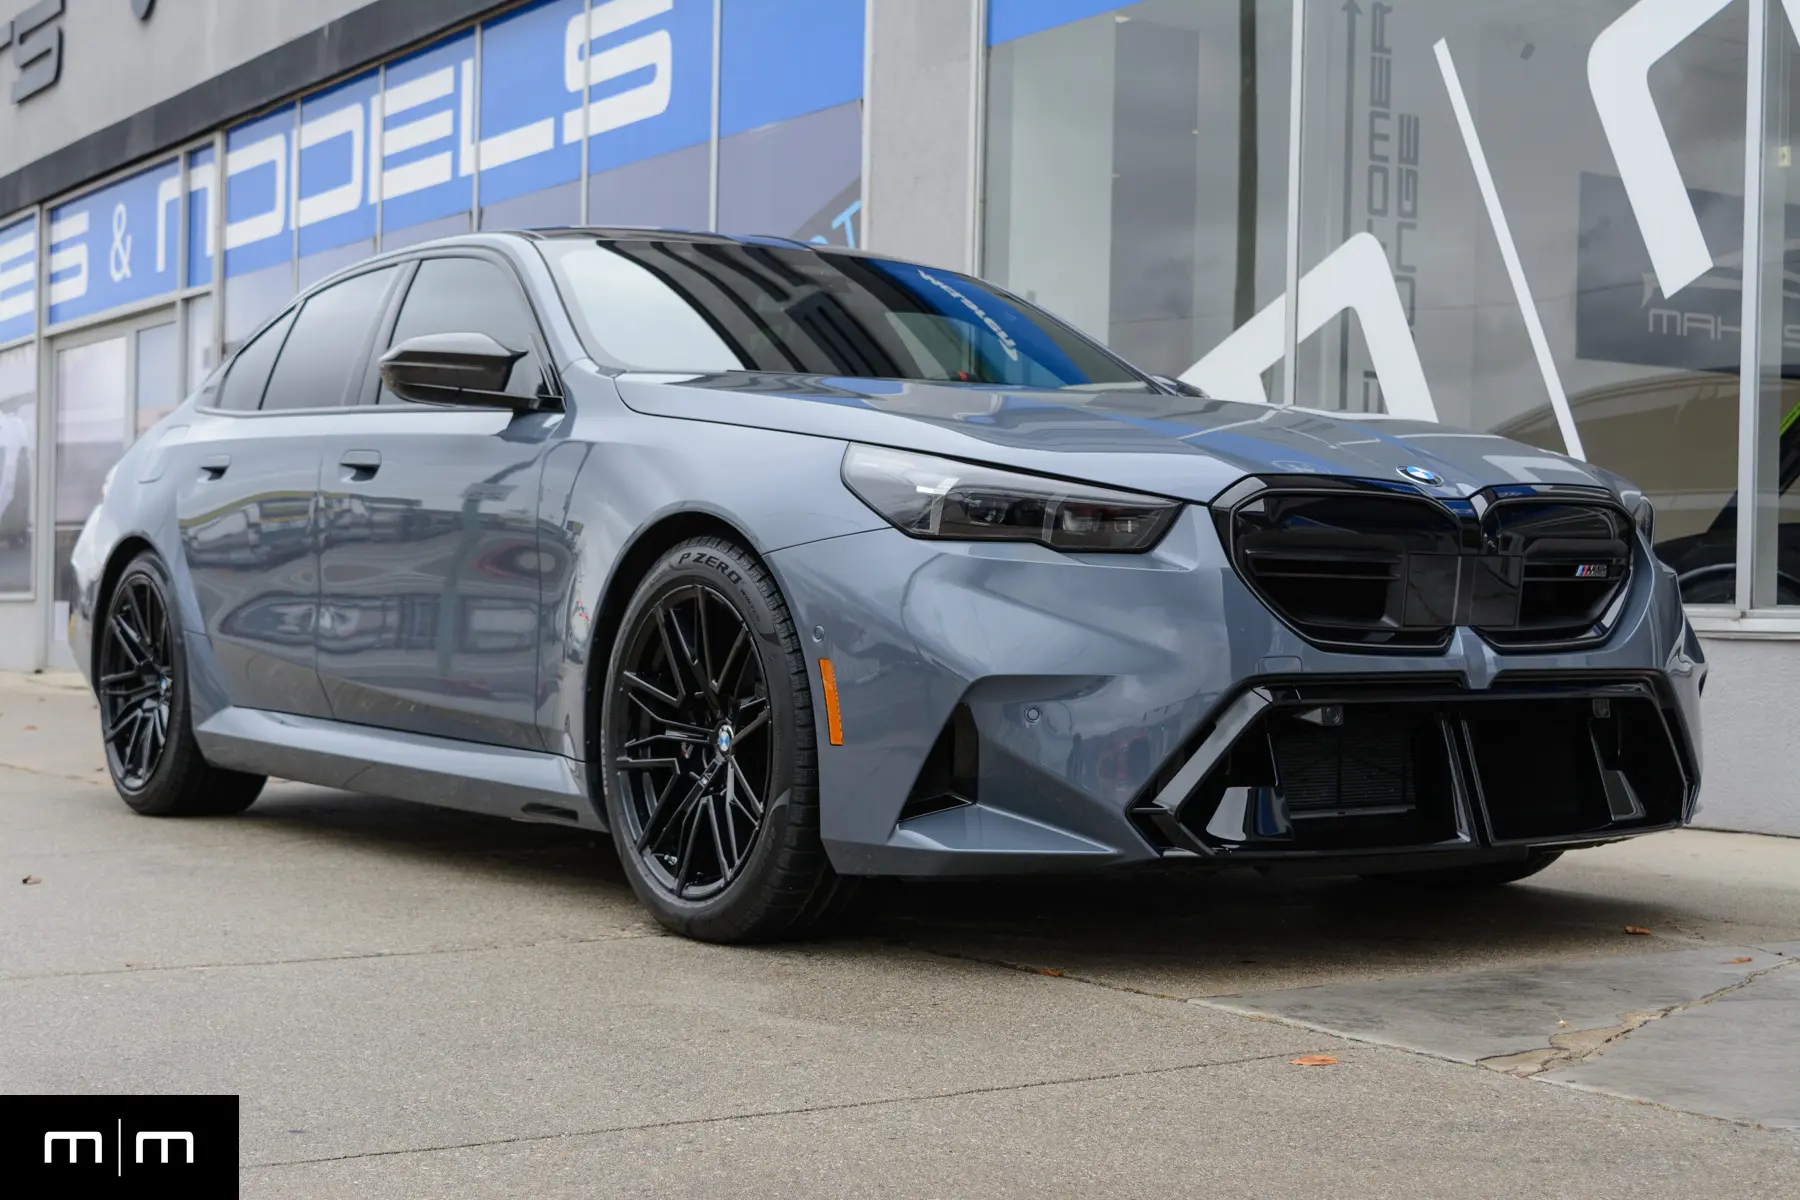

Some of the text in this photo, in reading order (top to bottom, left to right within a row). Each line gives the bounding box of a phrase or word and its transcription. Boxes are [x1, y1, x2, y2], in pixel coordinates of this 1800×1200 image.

[109, 203, 132, 282] &
[157, 0, 672, 273] MODELS
[693, 552, 742, 585] ZERO
